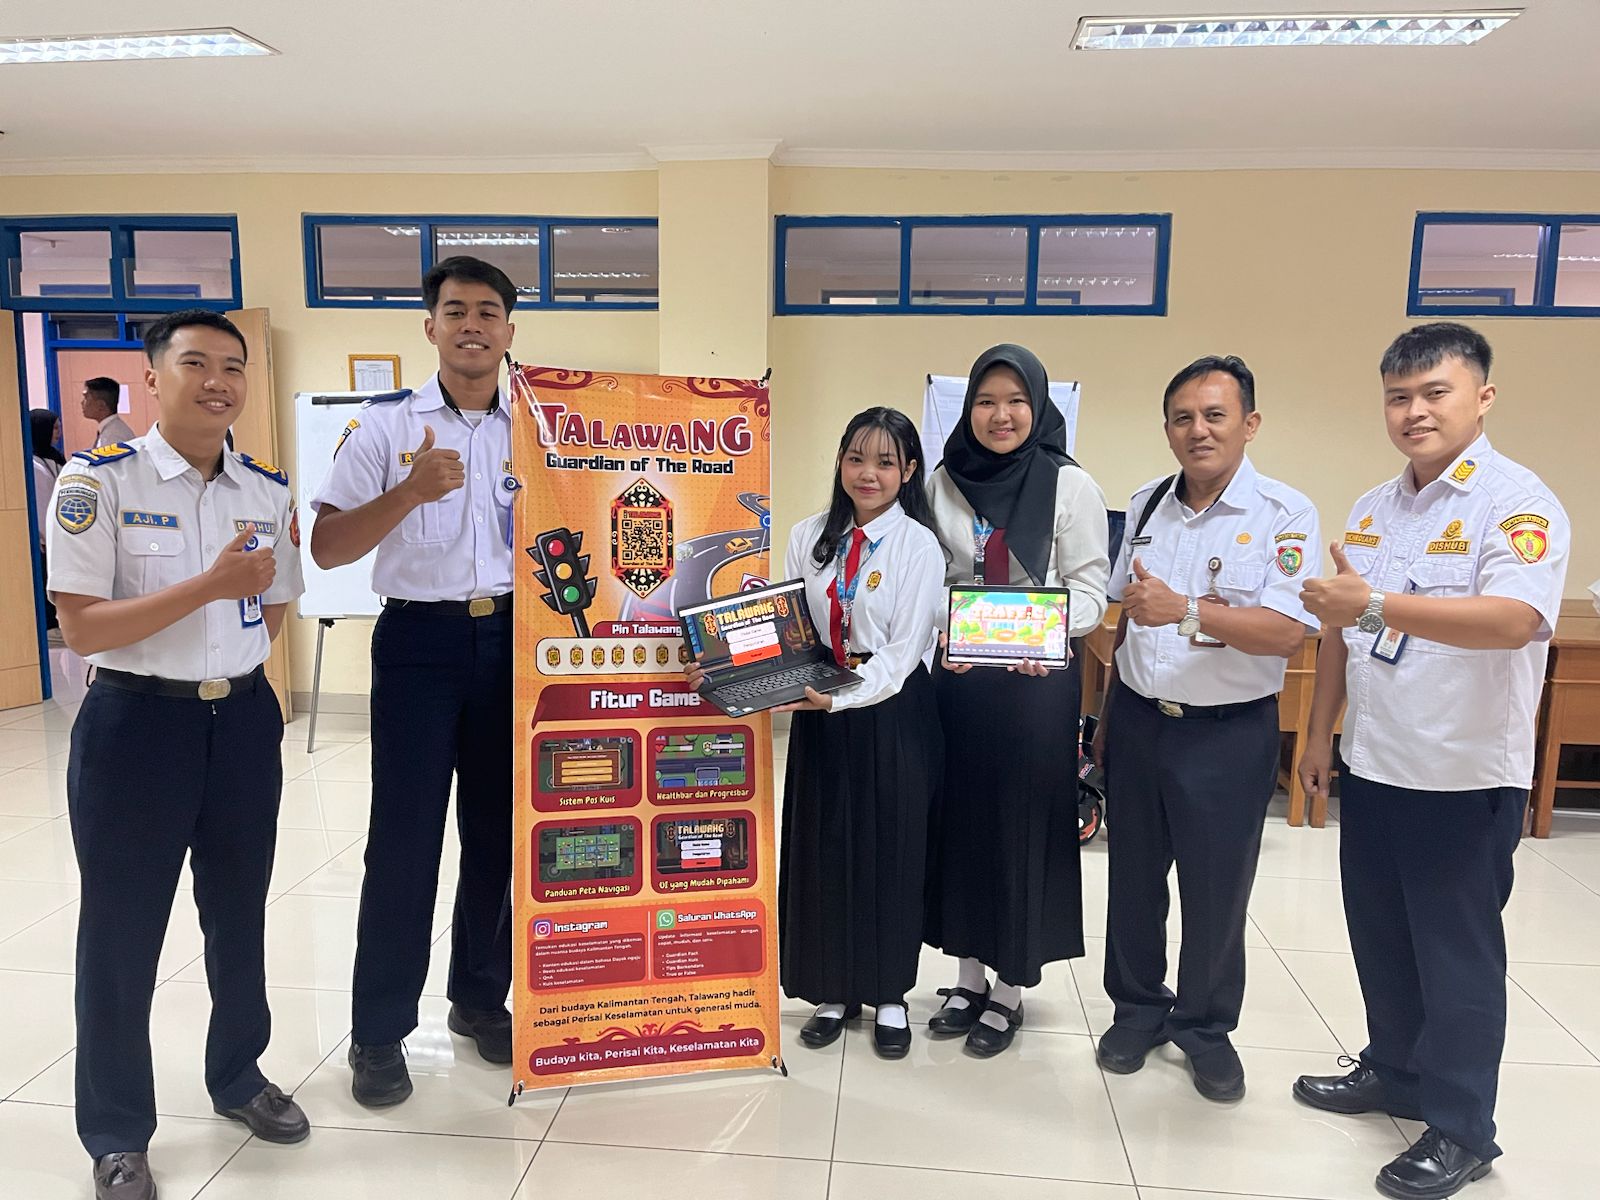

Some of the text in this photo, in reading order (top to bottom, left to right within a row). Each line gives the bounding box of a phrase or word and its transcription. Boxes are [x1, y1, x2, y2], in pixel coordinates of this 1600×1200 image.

[530, 403, 753, 455] TALAWANG
[546, 453, 734, 474] Guardian of The Road
[1430, 541, 1466, 551] DISHUB
[612, 624, 682, 636] Pin Talawang
[590, 689, 701, 709] Fitur Game
[560, 795, 616, 806] Sistem Pos Kuis
[657, 791, 693, 800] Healthbar
[710, 789, 749, 800] Progresbar
[670, 880, 688, 890] yang
[690, 878, 715, 887] Mudah
[716, 877, 749, 886] Dipahami
[545, 884, 630, 897] Panduan Peta Navigasi
[677, 910, 757, 922] Saluran WhatsApp
[554, 920, 608, 933] Instagram
[540, 988, 756, 1015] Dari budaya Kalimantan Tengah, Talawang hadir
[533, 999, 762, 1029] sebagai Perisai Keselamatan untuk generasi muda.
[535, 1036, 759, 1068] Budaya kita, Perisai Kita, Keselamatan Kita
